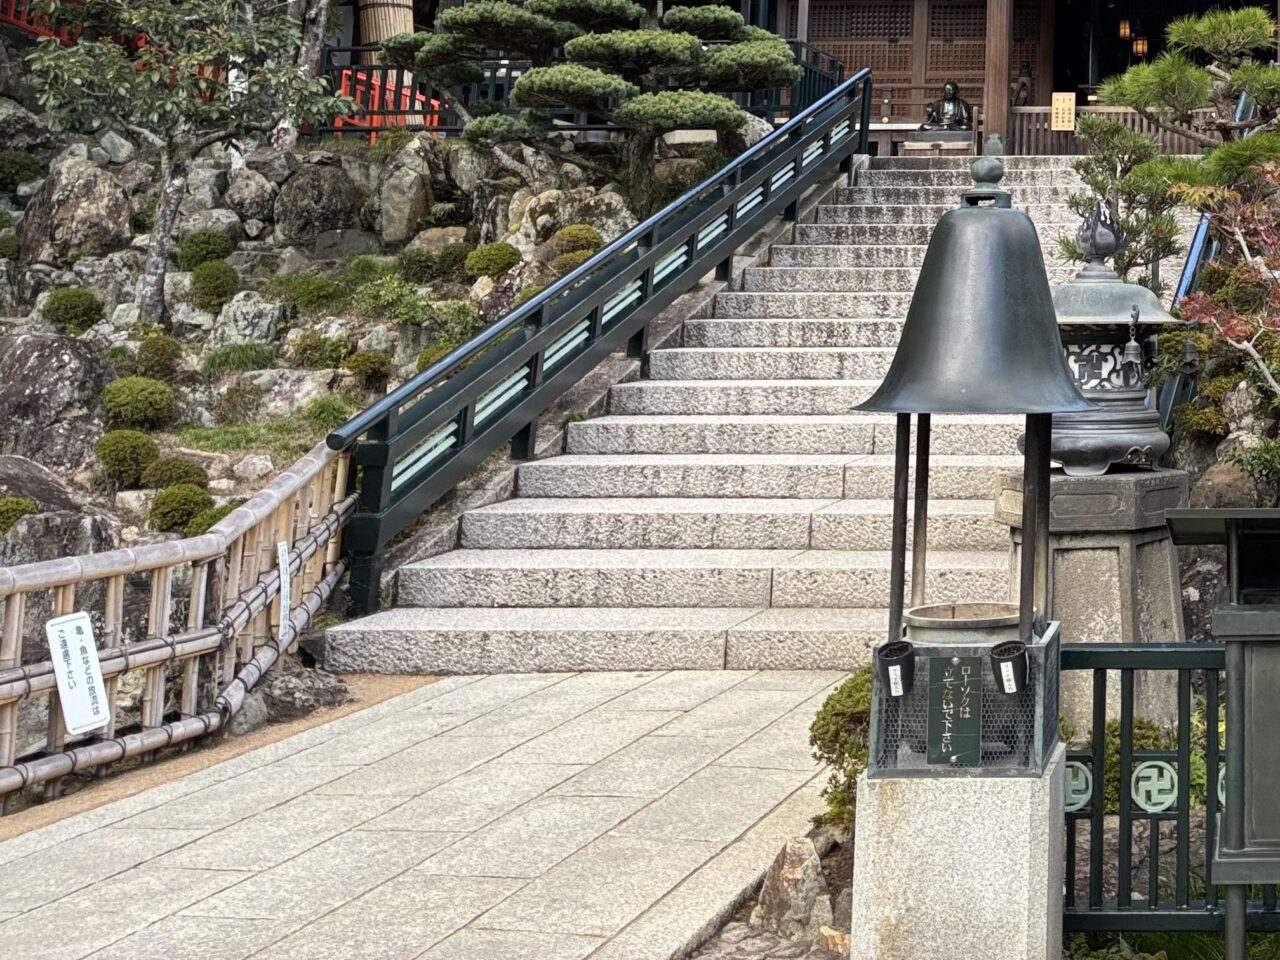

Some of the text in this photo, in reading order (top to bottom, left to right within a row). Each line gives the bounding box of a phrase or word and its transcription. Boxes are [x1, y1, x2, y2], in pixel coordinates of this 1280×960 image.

[57, 629, 77, 690] ご遠慮下さい
[75, 625, 101, 715] 亀・魚などの放流は
[959, 666, 971, 719] ローソクは
[941, 666, 954, 753] 立てないで下さい
